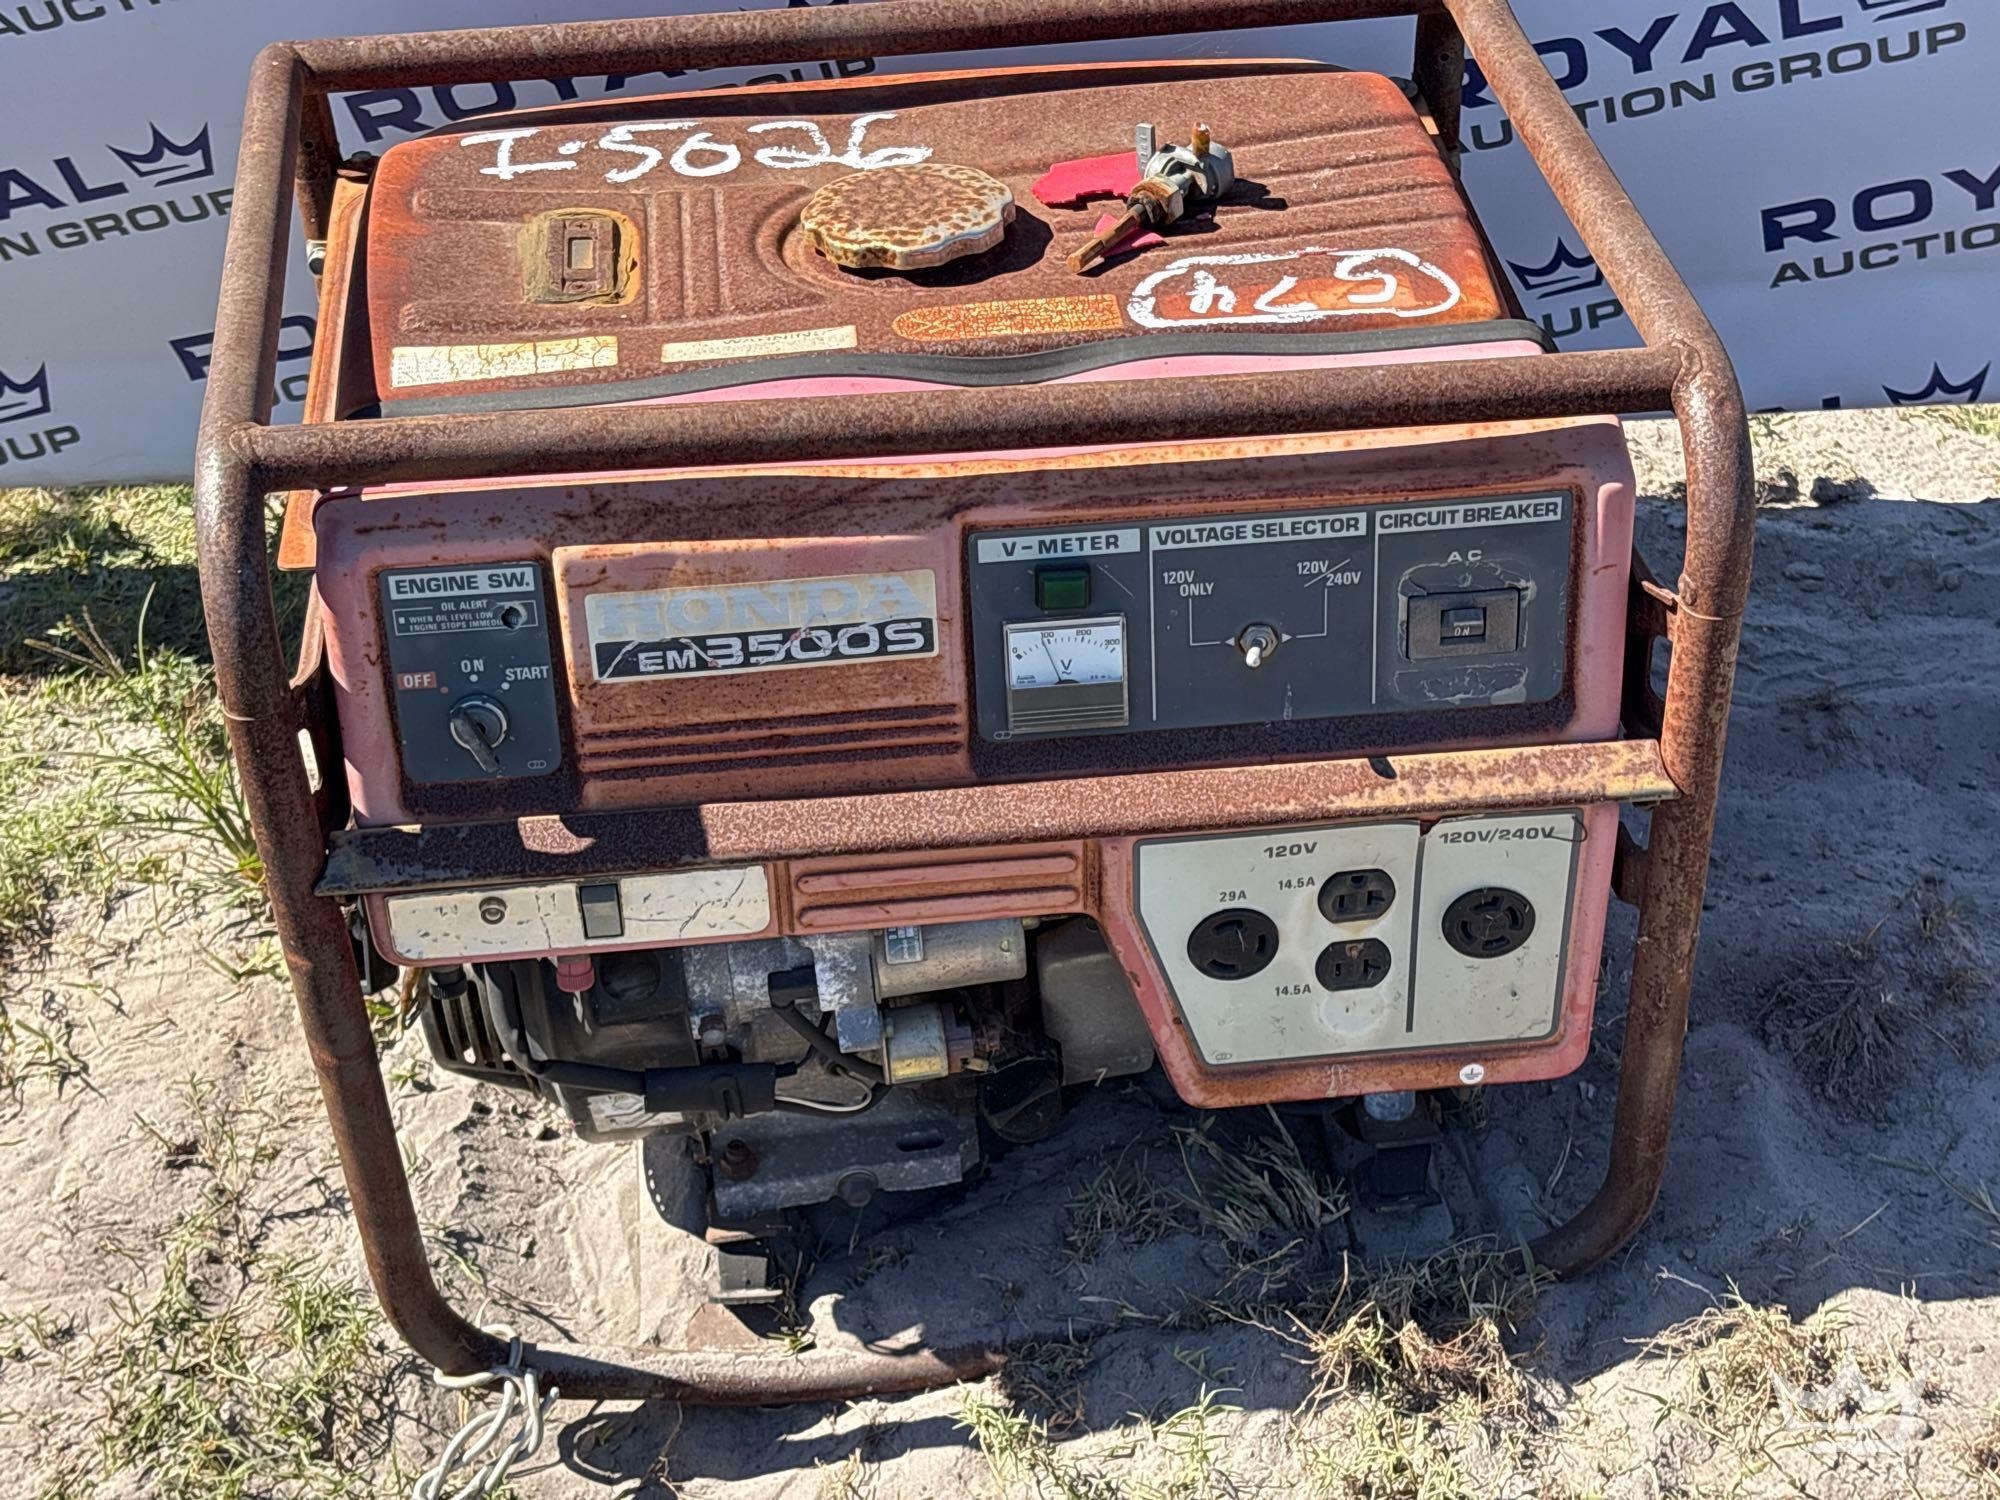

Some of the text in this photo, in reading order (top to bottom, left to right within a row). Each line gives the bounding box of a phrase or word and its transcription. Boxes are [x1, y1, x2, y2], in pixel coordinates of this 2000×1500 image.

[1731, 21, 1966, 93] GROUP
[1379, 501, 1559, 530] CIRCUIT BREAKER
[1155, 516, 1360, 546] VOLTAGE SELECTOR
[1296, 559, 1329, 576] 120V
[395, 572, 530, 595] ENGINE SW.
[1162, 569, 1196, 585] 120V
[1325, 571, 1363, 587] 240V
[1179, 582, 1215, 598] ONLY
[441, 599, 489, 612] OIL ALERT
[598, 575, 932, 638] HONDA
[409, 611, 494, 625] WHEN OIL LEVEL LOW
[409, 623, 438, 633] ENGINE
[441, 621, 467, 631] STOPS
[1040, 631, 1055, 639] 100
[1075, 628, 1092, 636] 200
[1454, 626, 1471, 637] ON
[1011, 646, 1018, 654] 0
[1104, 638, 1120, 646] 300
[460, 658, 485, 674] ON
[1060, 658, 1073, 671] V
[403, 673, 432, 689] OFF
[504, 665, 550, 682] START
[1438, 825, 1556, 845] 120V/240V
[1263, 842, 1318, 859] 120V
[1277, 876, 1316, 891] 14.5A
[1218, 889, 1248, 903] 29A
[1274, 983, 1312, 997] 14.5A
